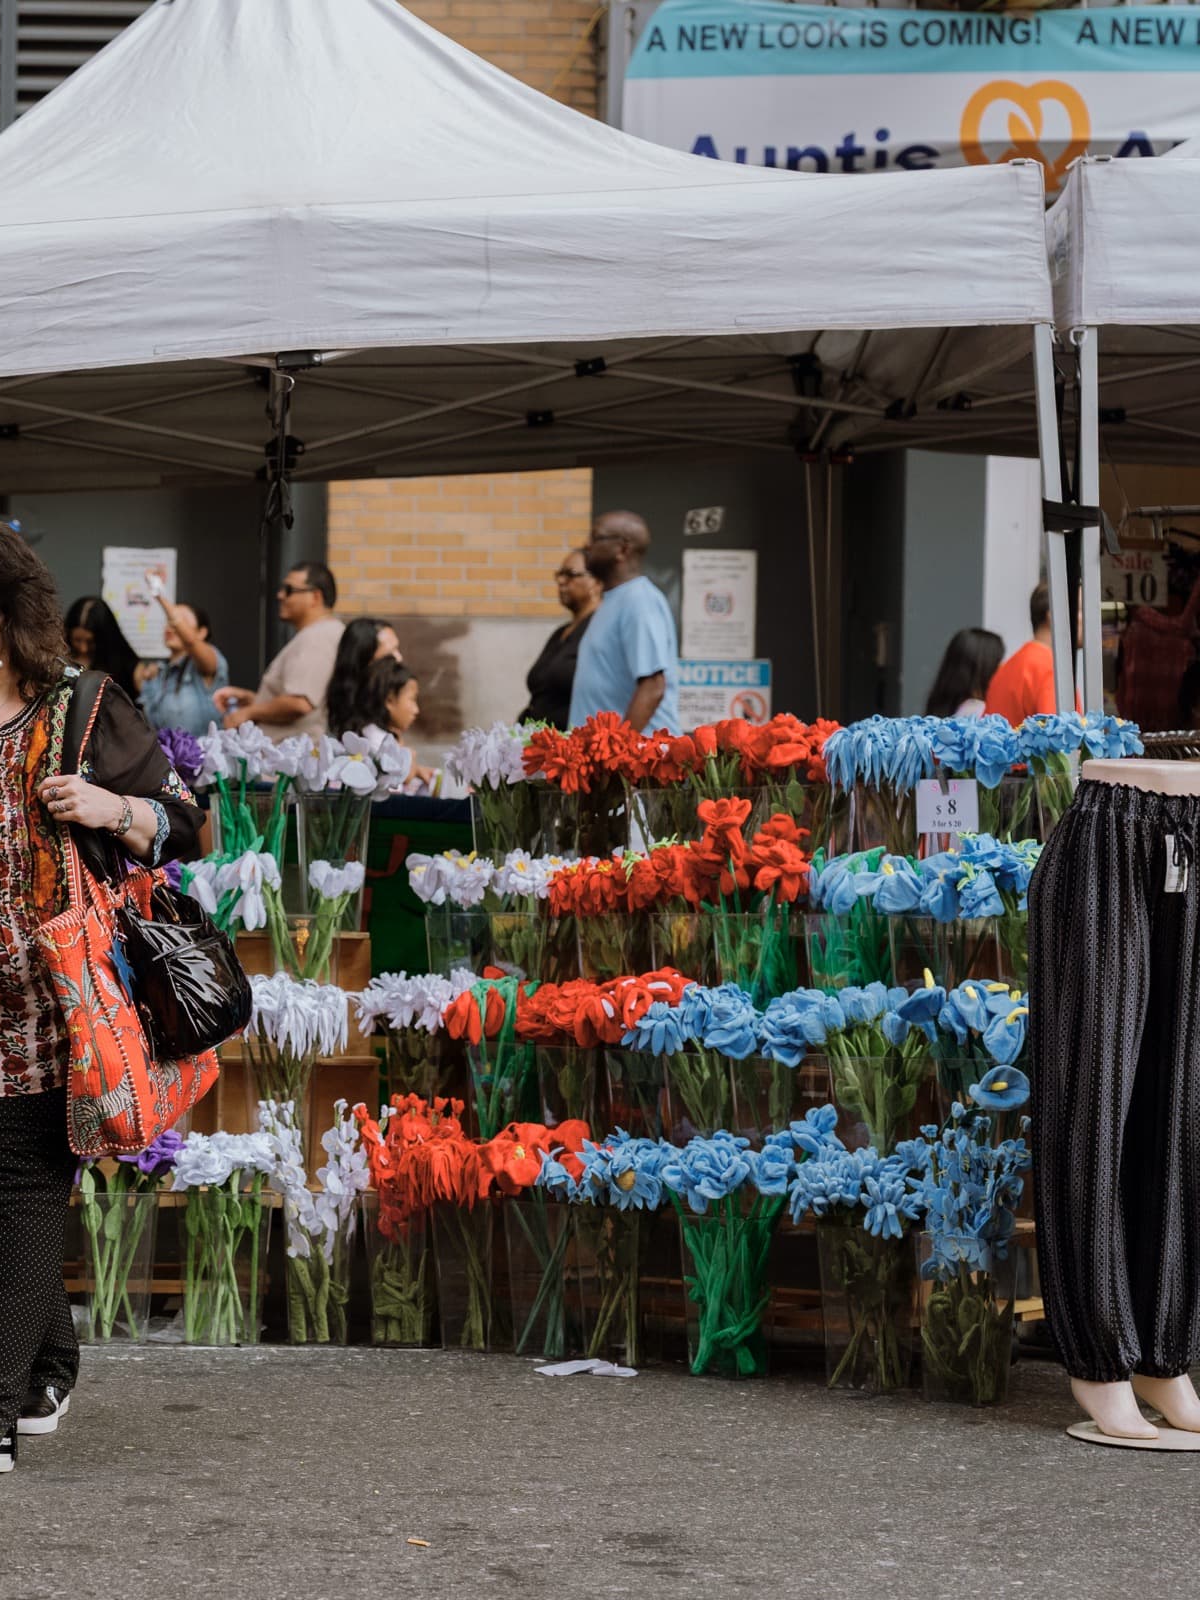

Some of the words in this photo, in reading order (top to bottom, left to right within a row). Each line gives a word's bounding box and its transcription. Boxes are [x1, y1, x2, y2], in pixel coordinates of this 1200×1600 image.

[647, 26, 666, 51] A
[677, 23, 749, 51] NEW
[759, 22, 849, 48] LOOK
[860, 20, 888, 48] IS
[900, 18, 1041, 47] COMING!
[1076, 18, 1098, 45] A
[1111, 18, 1186, 45] NEW
[688, 508, 720, 532] 66
[1111, 552, 1153, 571] Sale
[1123, 573, 1157, 603] 10
[678, 664, 760, 684] NOTICE
[931, 783, 958, 793] SE
[948, 799, 957, 815] 8
